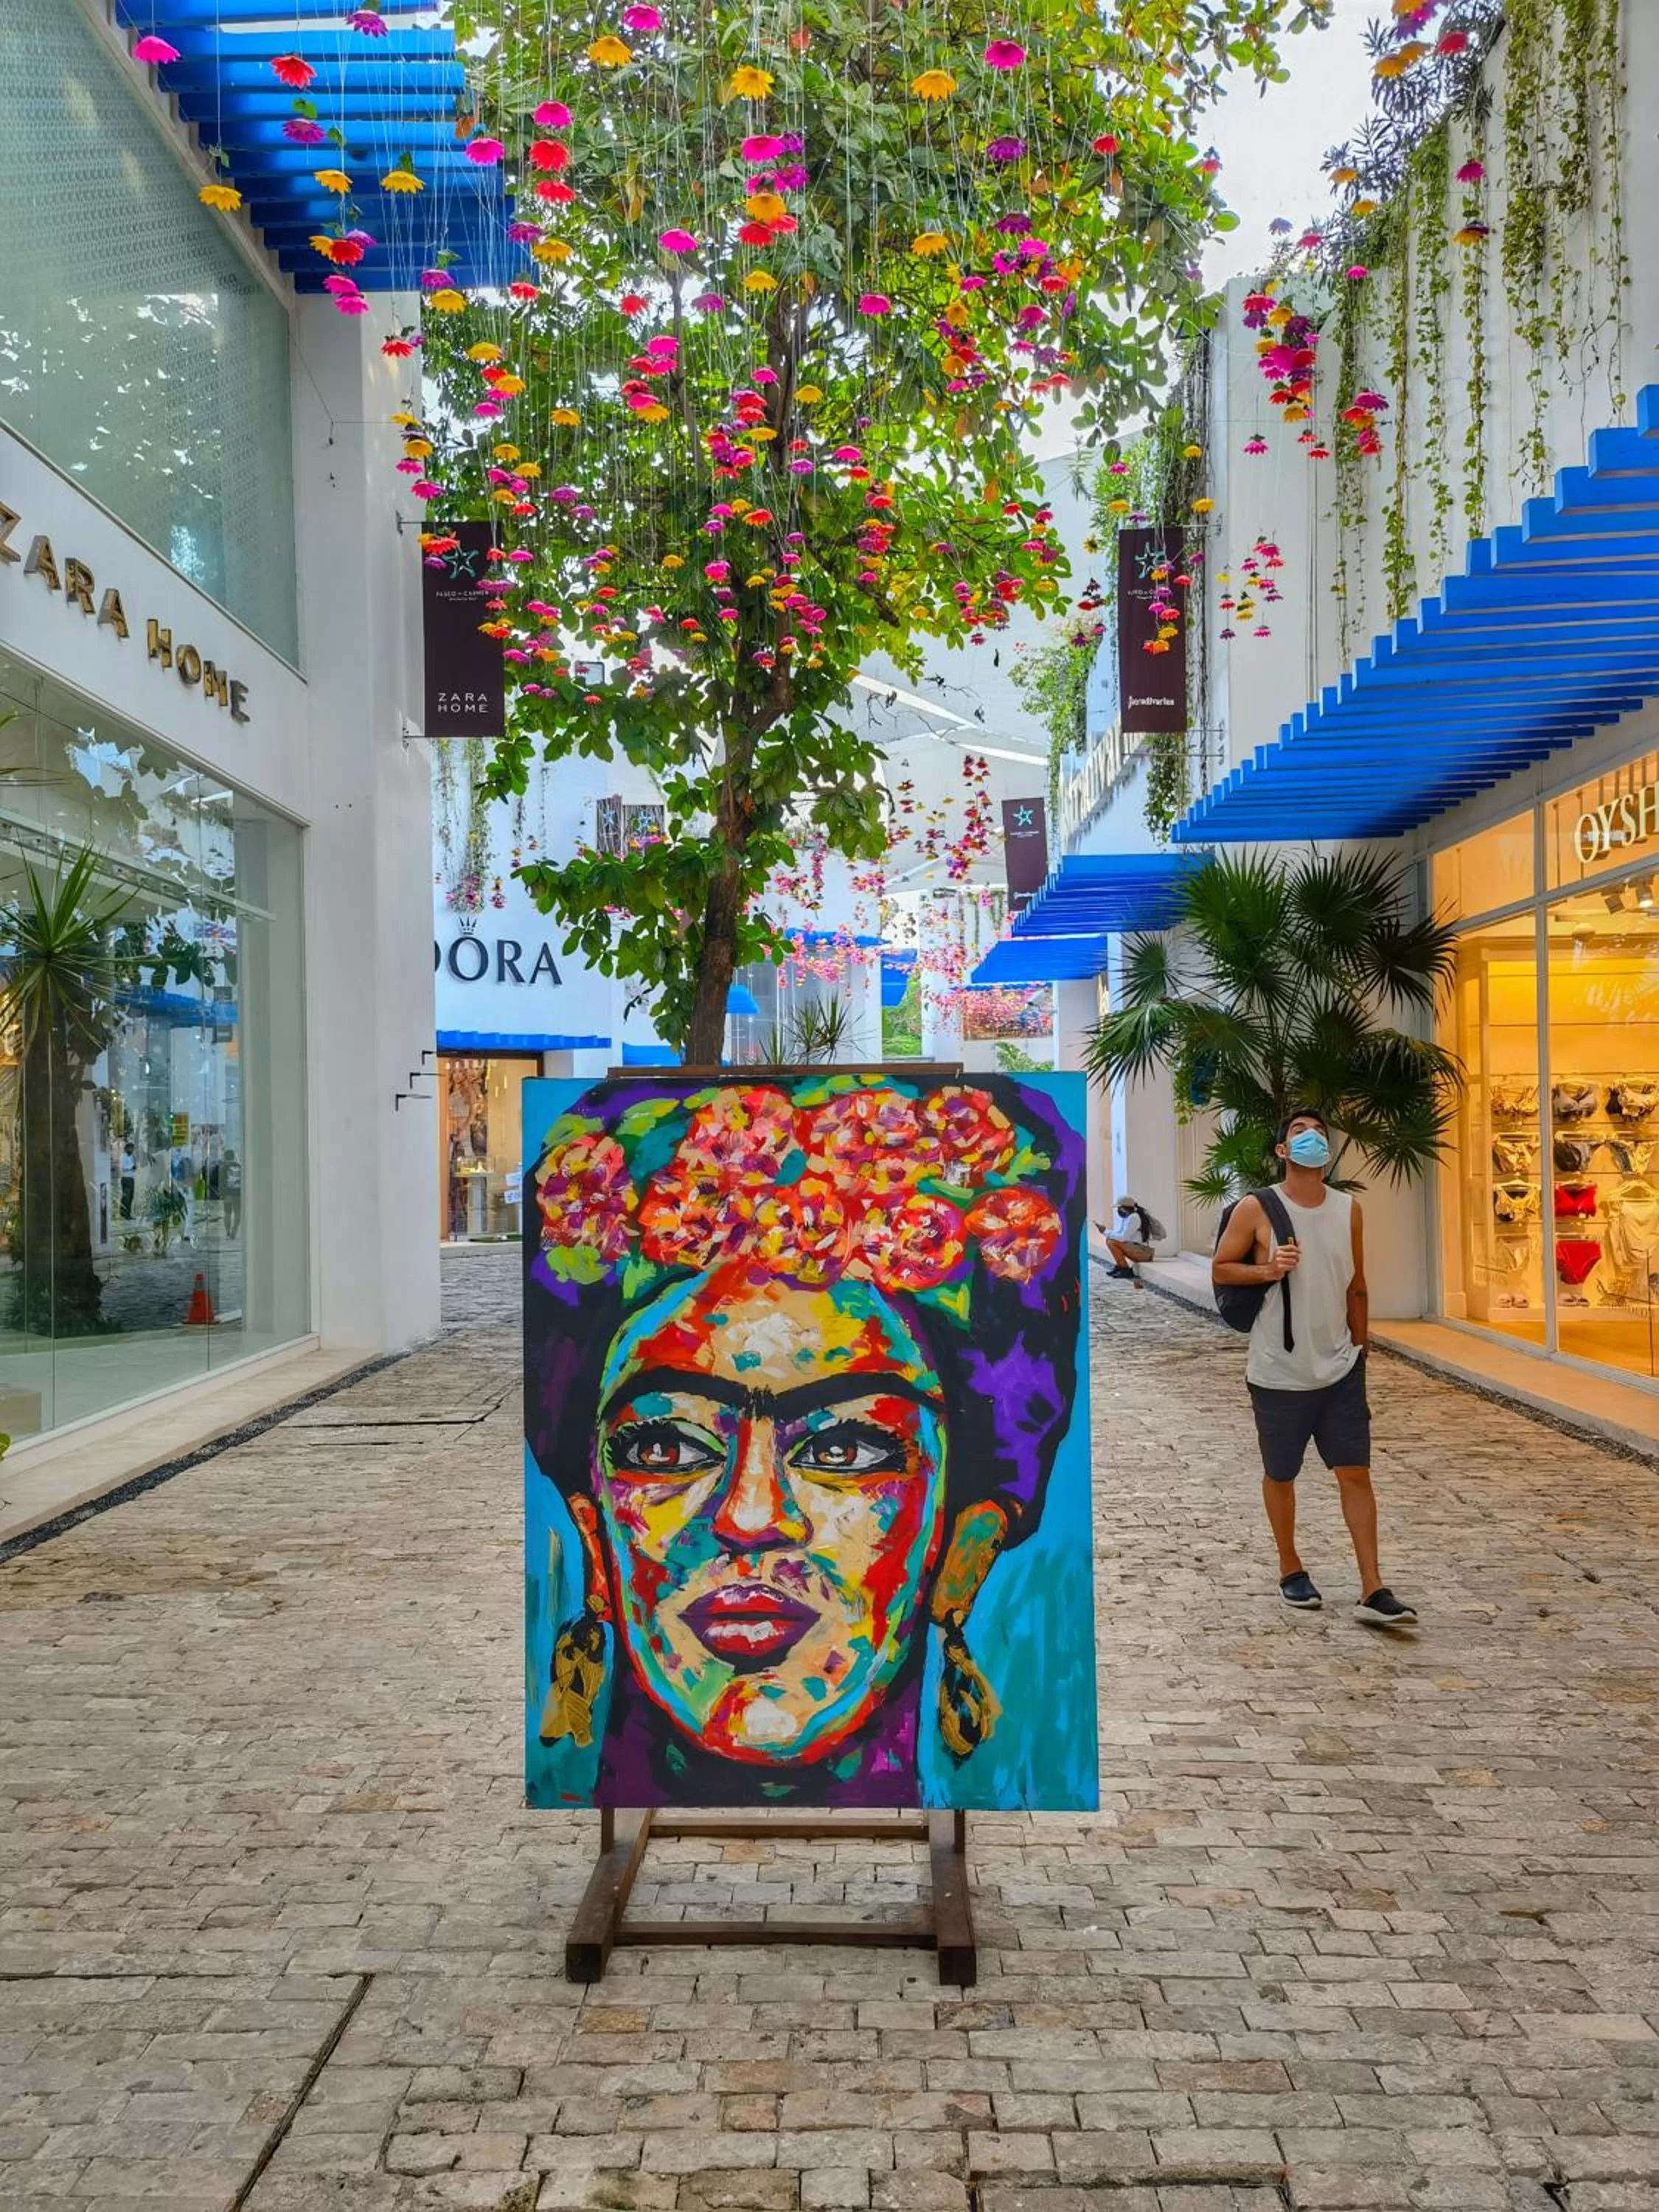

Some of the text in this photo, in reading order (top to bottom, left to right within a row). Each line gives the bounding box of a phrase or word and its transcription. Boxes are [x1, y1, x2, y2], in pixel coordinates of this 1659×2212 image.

[0, 501, 251, 723] ZARA HOME
[437, 703, 489, 713] HOME
[438, 692, 487, 702] ZARA
[1575, 782, 1659, 863] OYSH
[435, 936, 562, 985] ORA
